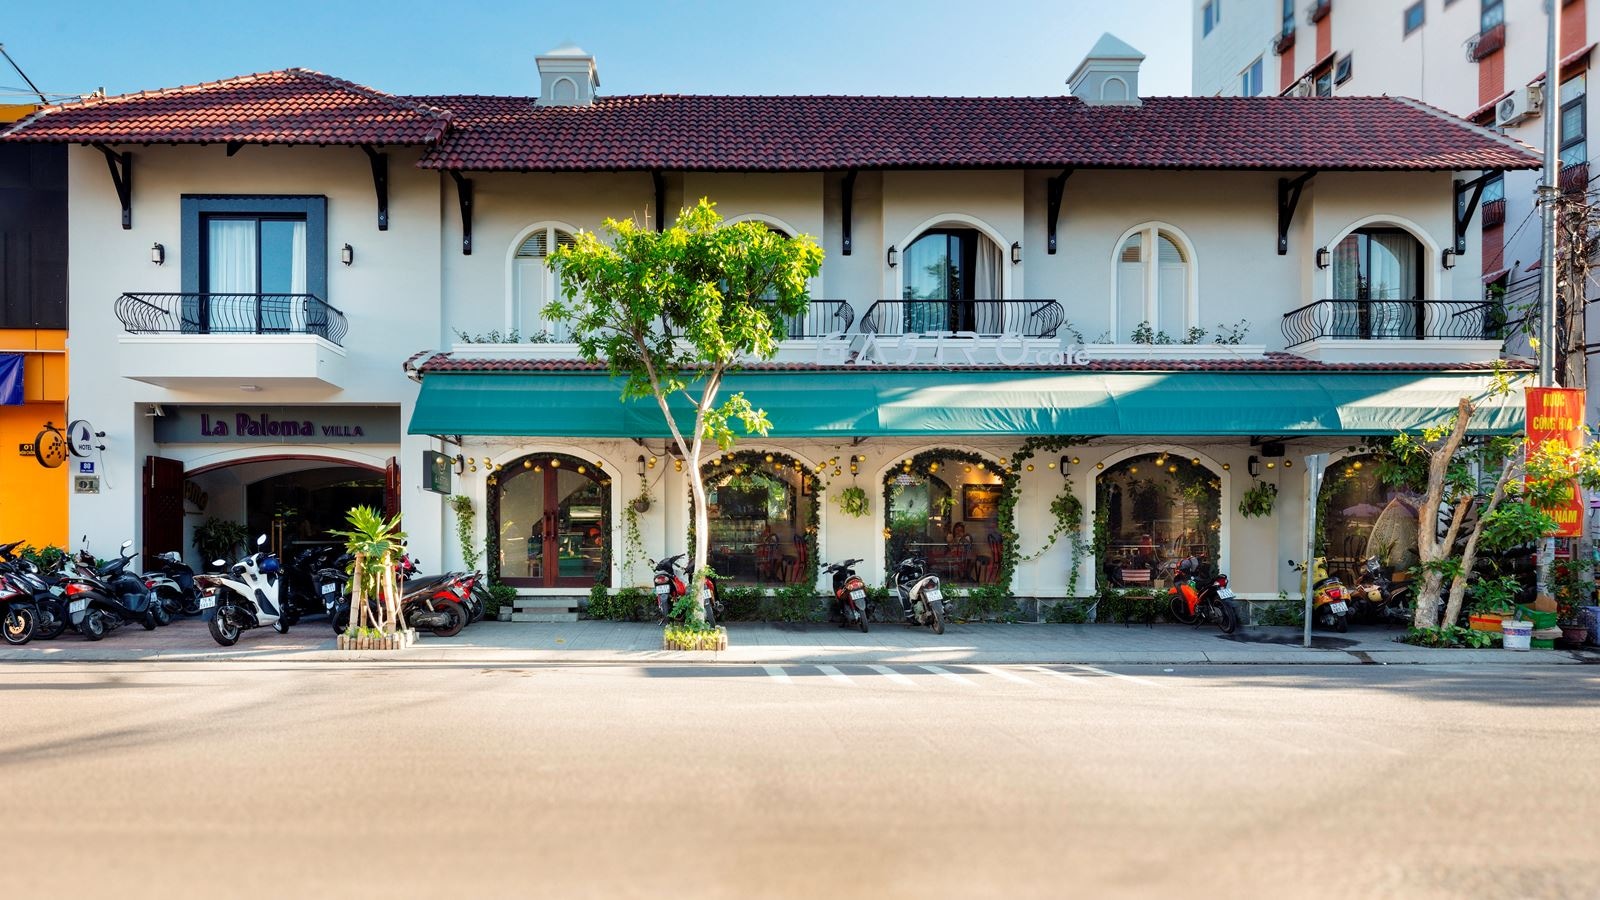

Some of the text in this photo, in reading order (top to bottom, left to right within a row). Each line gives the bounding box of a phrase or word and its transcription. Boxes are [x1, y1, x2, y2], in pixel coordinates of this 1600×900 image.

[816, 331, 1028, 366] GASTRO
[200, 412, 364, 437] La Paloma VILLA
[78, 443, 92, 451] HOTEL
